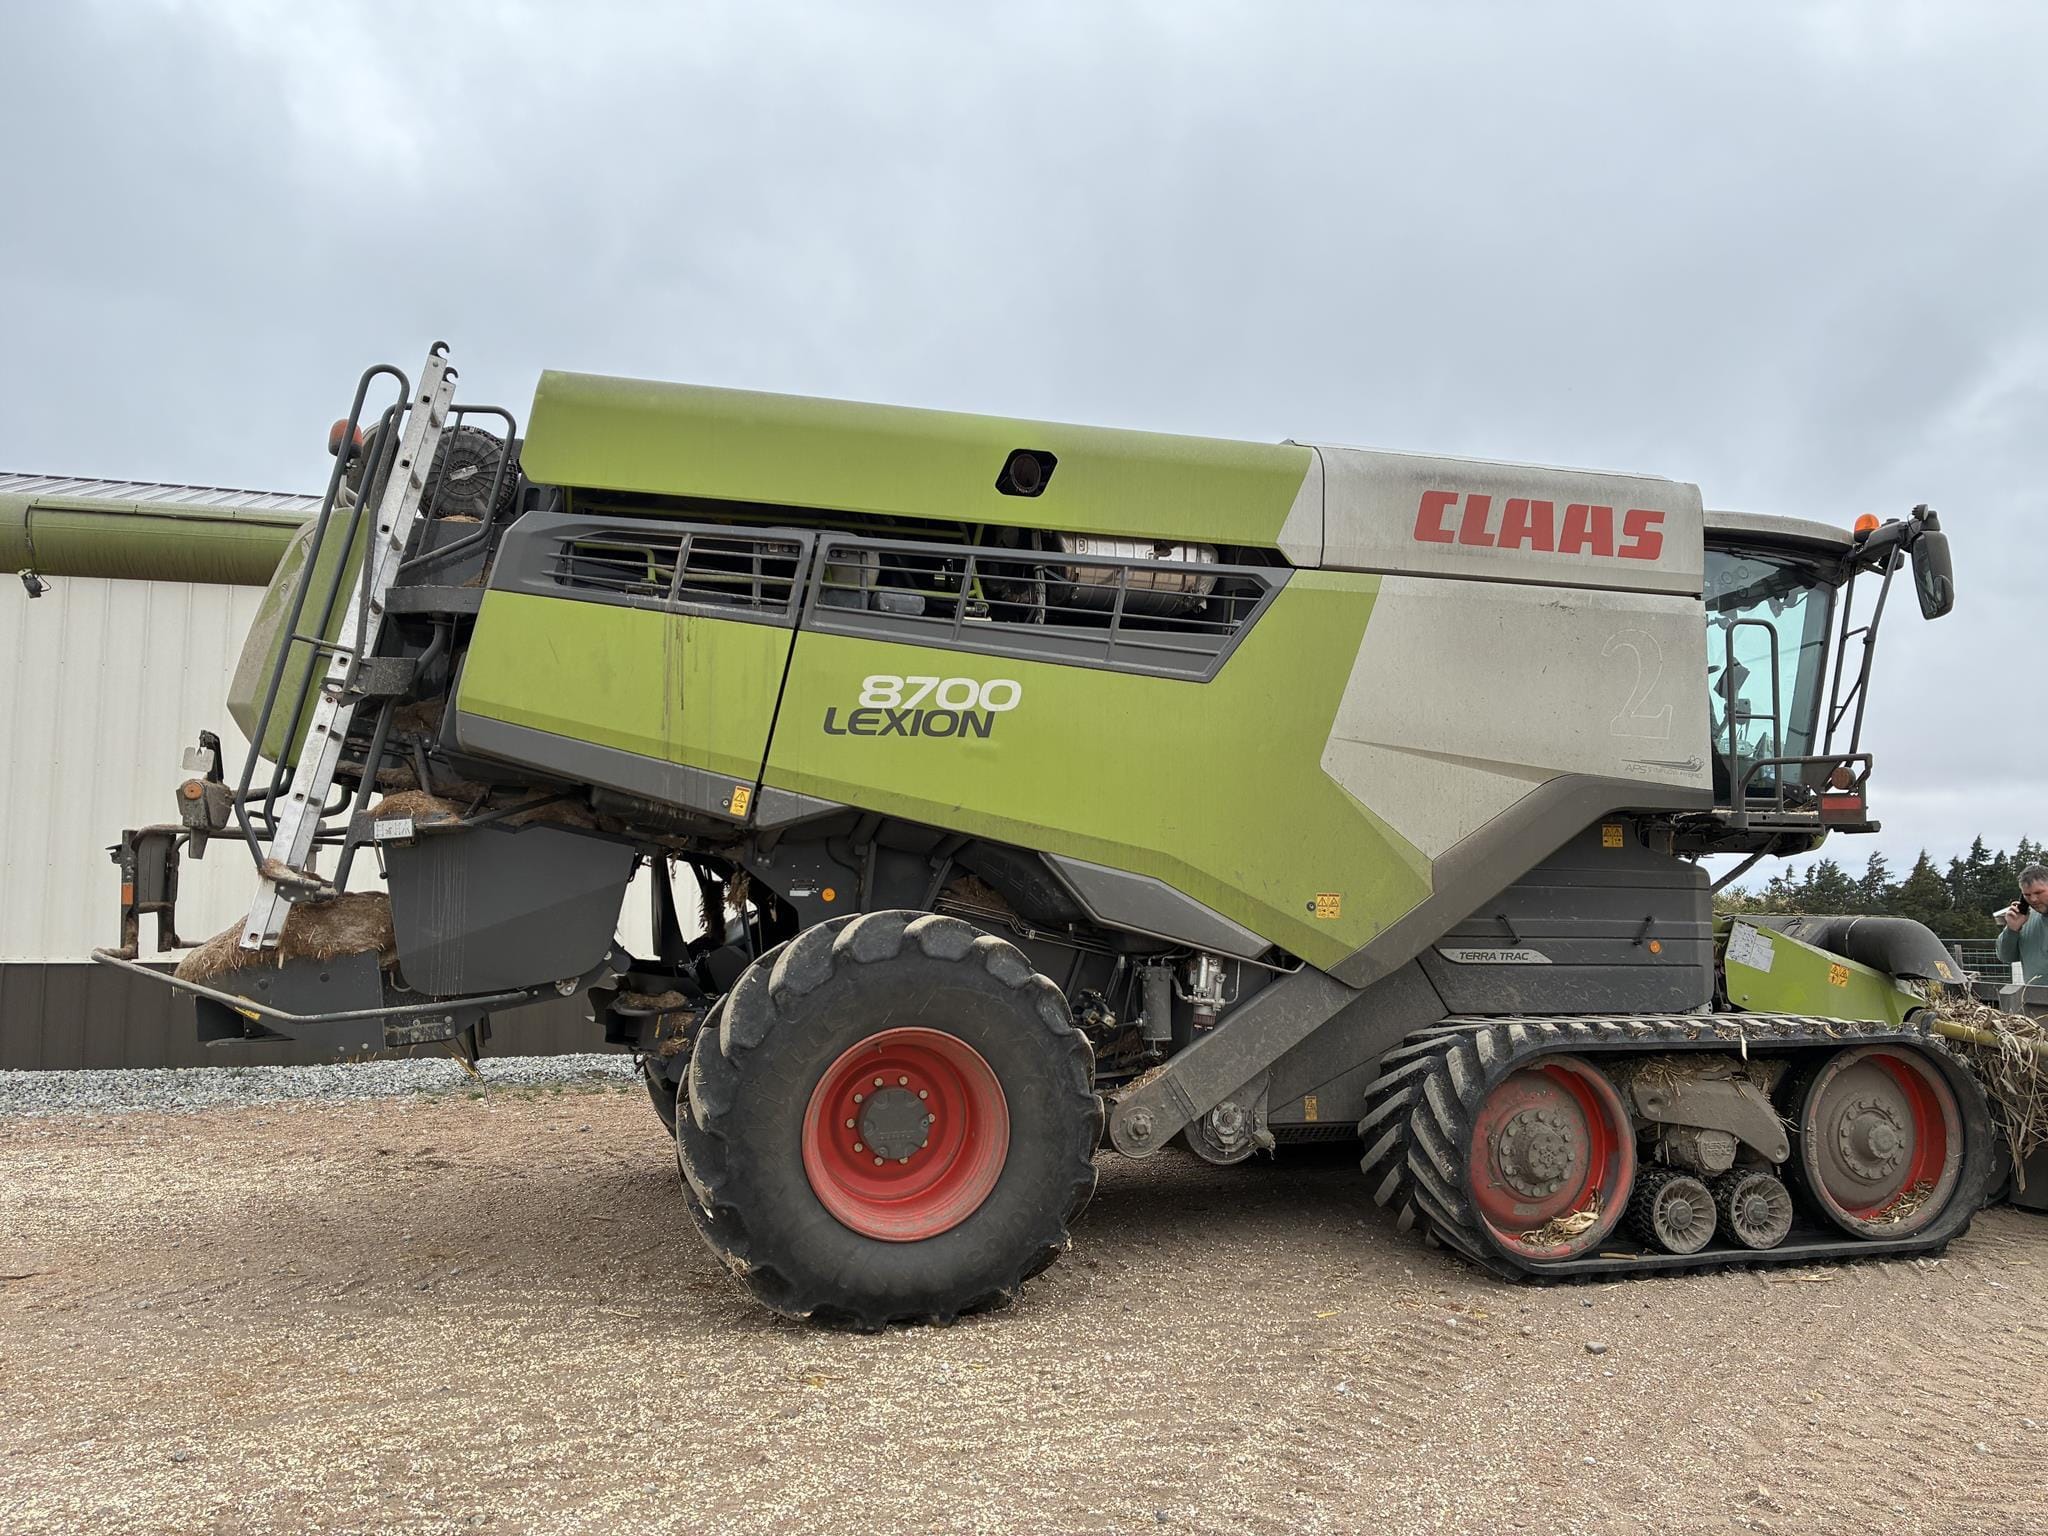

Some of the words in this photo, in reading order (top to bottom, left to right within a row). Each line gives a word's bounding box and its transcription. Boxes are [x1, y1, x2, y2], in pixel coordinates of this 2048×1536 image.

[1414, 490, 1665, 560] CLAAS
[858, 675, 1021, 711] 8700
[1601, 629, 1673, 739] 2
[823, 707, 995, 737] LEXION
[1459, 951, 1496, 961] TERRA
[1499, 951, 1530, 961] TRAC
